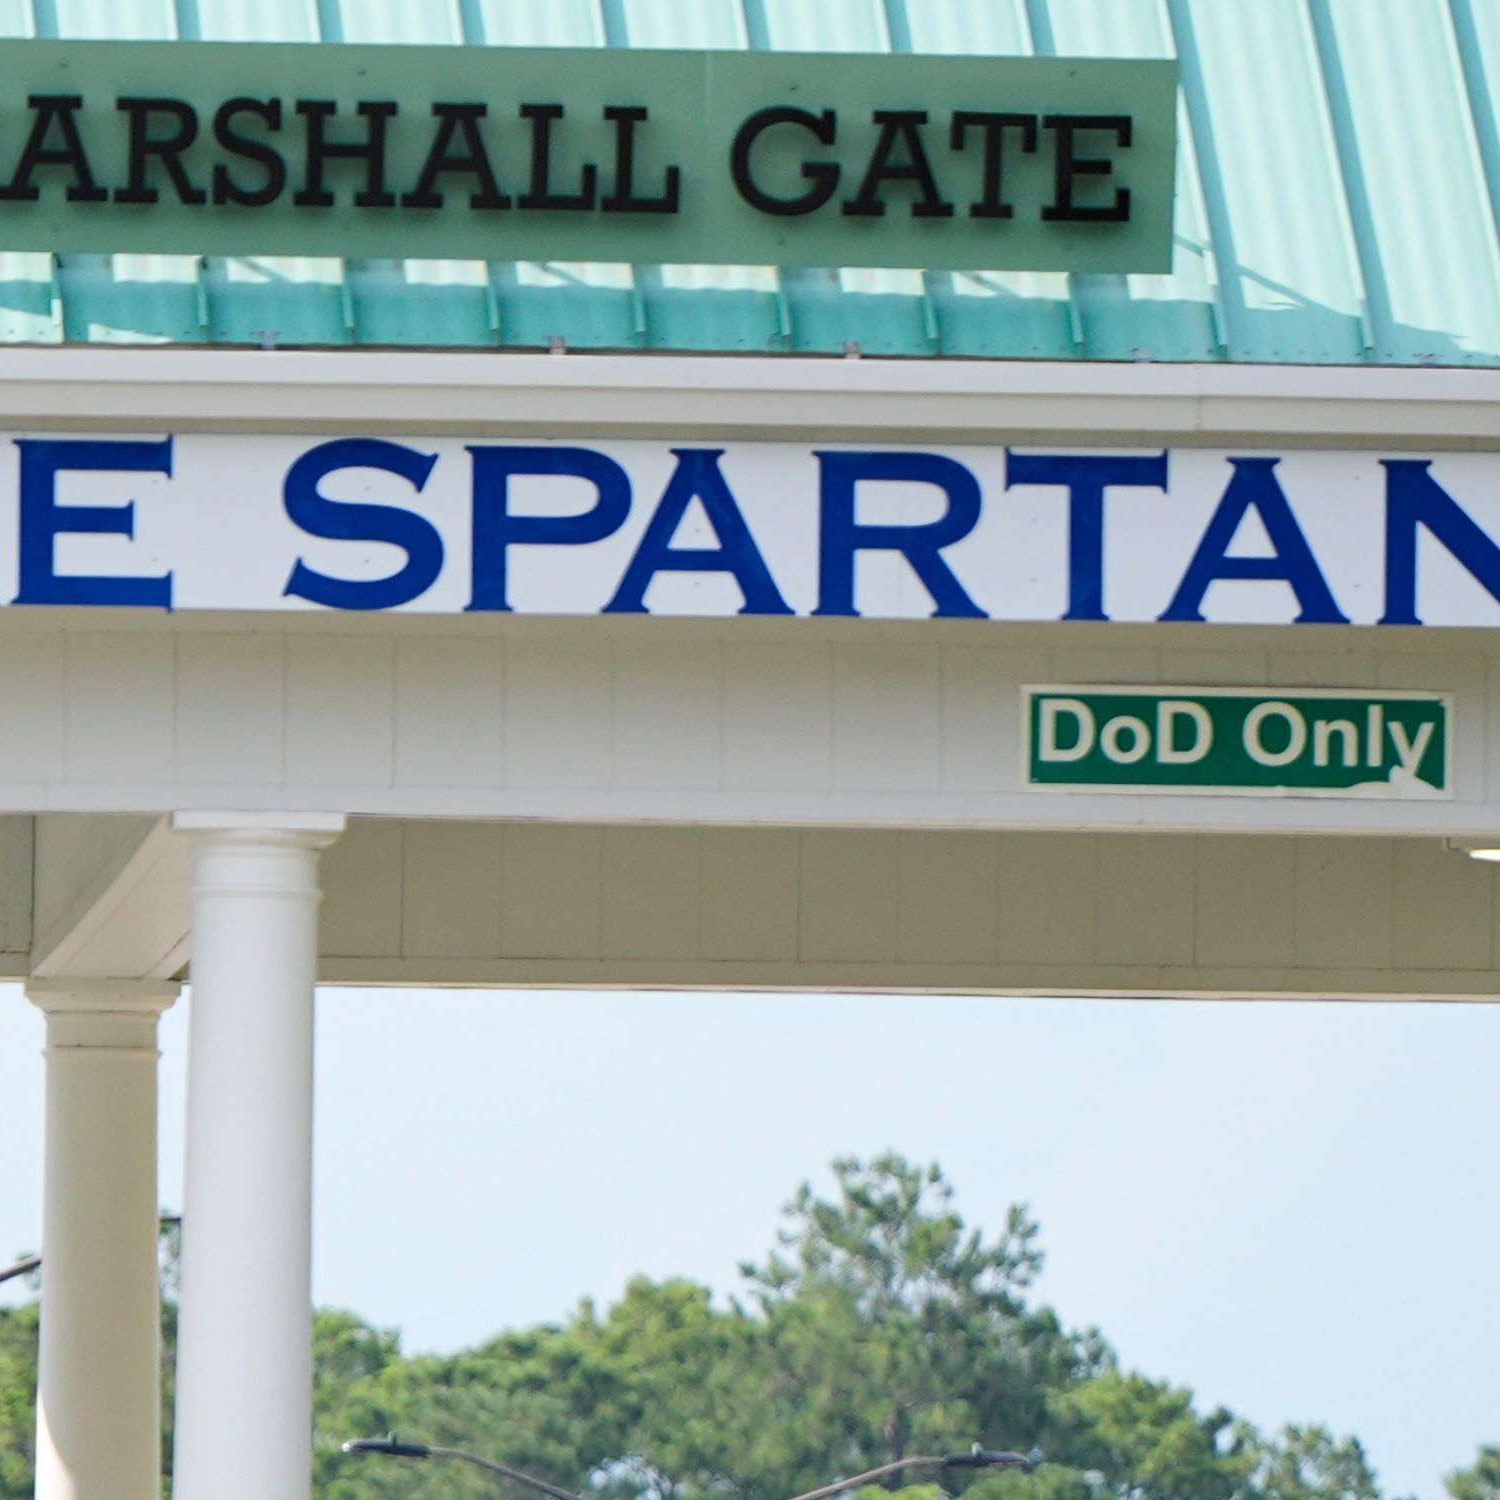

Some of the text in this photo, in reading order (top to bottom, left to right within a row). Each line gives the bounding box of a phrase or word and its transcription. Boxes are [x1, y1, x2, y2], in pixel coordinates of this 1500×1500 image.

[728, 107, 1132, 225] GATE
[282, 436, 1500, 626] SPARTAN
[1037, 698, 1436, 773] DoD Only
